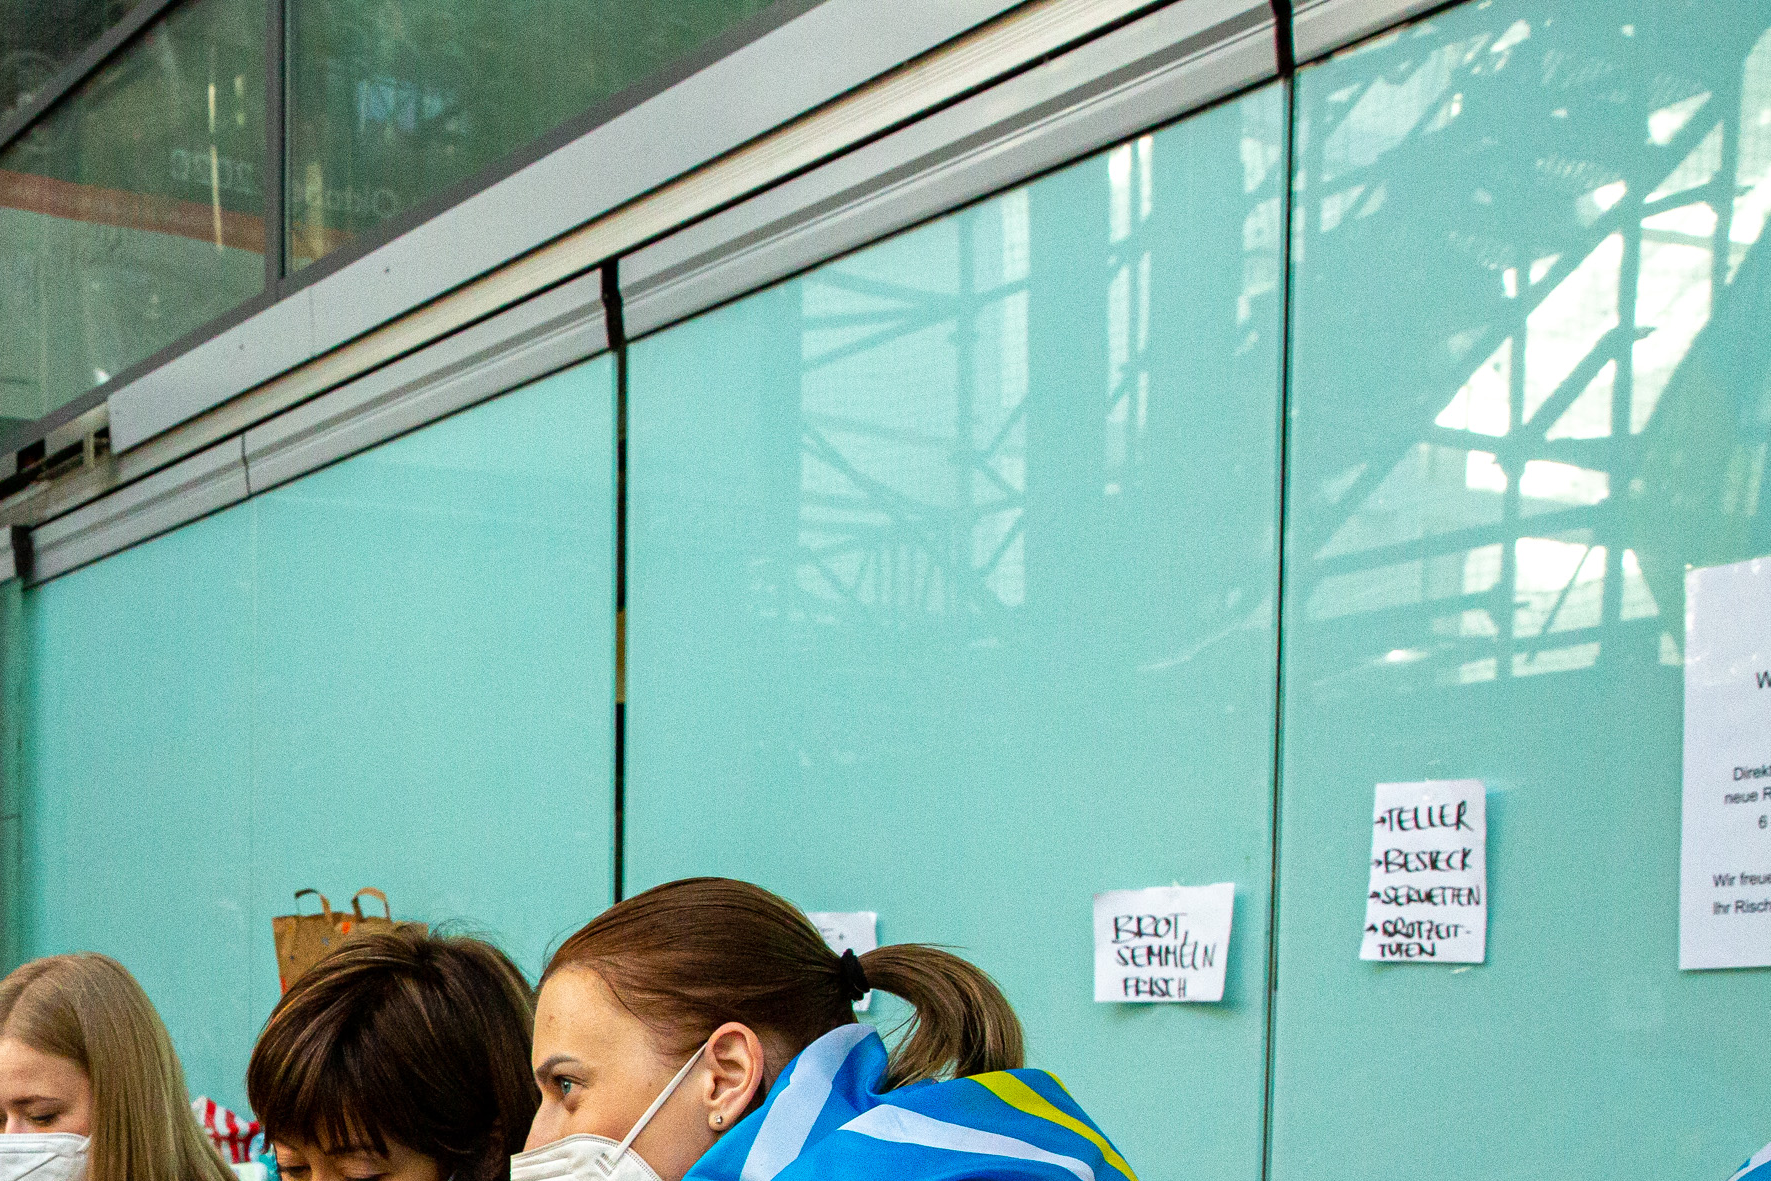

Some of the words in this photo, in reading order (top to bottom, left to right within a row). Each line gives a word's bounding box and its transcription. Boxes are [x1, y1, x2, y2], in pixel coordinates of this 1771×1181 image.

[1723, 790, 1759, 805] neue
[1384, 800, 1474, 832] TELLER
[1712, 873, 1736, 887] Wir
[1712, 901, 1731, 915] Ihr
[1115, 939, 1217, 971] SEMMELN
[1122, 976, 1188, 998] FRISCH
